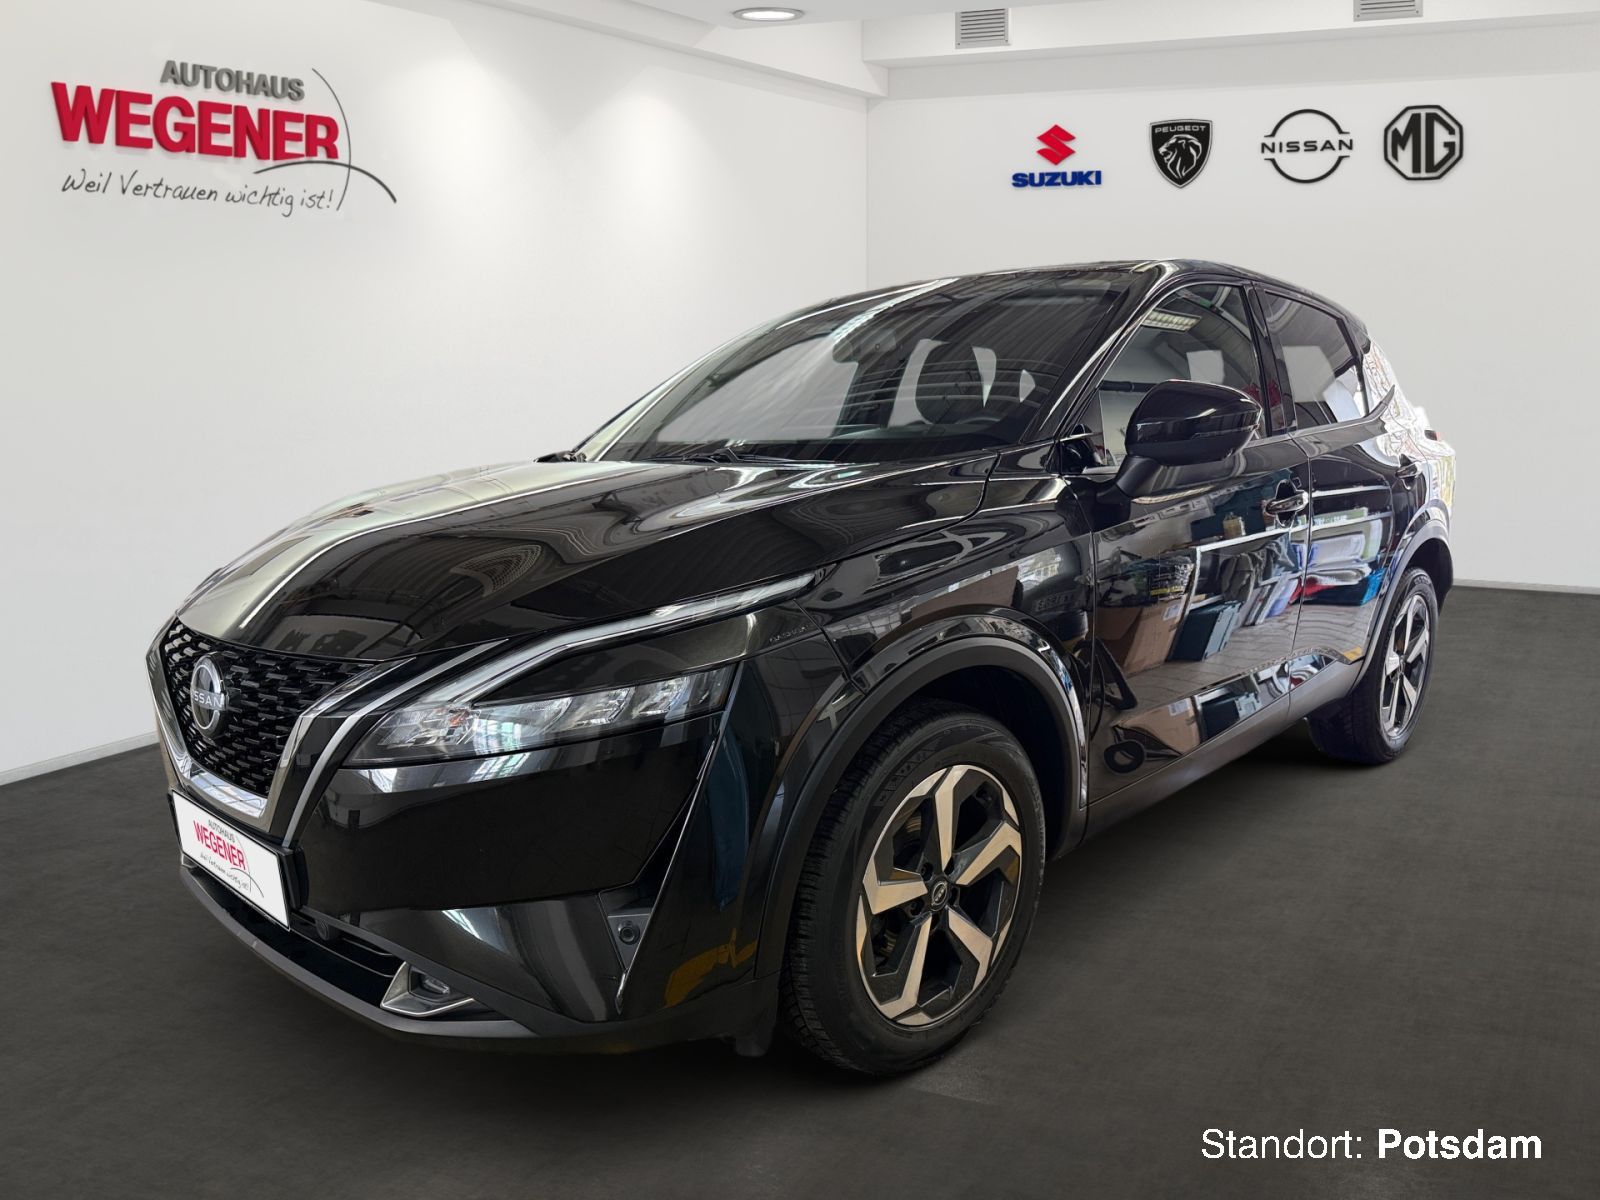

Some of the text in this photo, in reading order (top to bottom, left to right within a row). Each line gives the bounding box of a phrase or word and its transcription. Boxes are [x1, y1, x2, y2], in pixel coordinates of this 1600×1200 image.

[160, 60, 305, 101] AUTOHAUS
[51, 81, 340, 161] WEGENER
[1154, 125, 1207, 134] PEUGEOT
[1391, 112, 1457, 174] MG
[1261, 138, 1354, 154] NISSAN
[61, 168, 334, 218] Weil Vertrauen wichtig ist!
[1011, 170, 1102, 188] SUZUKI
[193, 820, 247, 871] WEGENER
